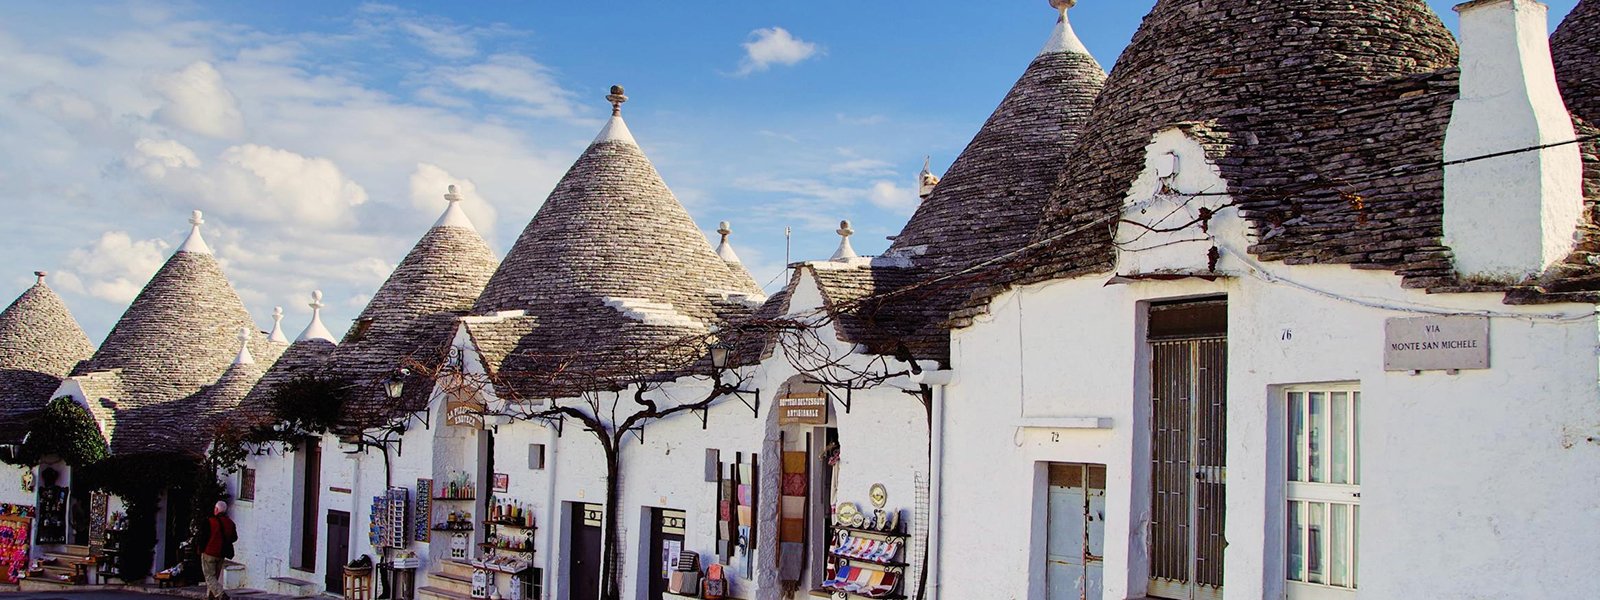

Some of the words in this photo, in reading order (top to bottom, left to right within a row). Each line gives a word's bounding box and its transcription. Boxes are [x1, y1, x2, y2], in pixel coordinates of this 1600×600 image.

[1281, 328, 1292, 341] 76
[1425, 325, 1440, 333] VIA
[1391, 342, 1420, 351] MONTE
[1422, 341, 1439, 350] SAN
[1441, 340, 1478, 349] MICHELE
[1051, 431, 1060, 443] 72
